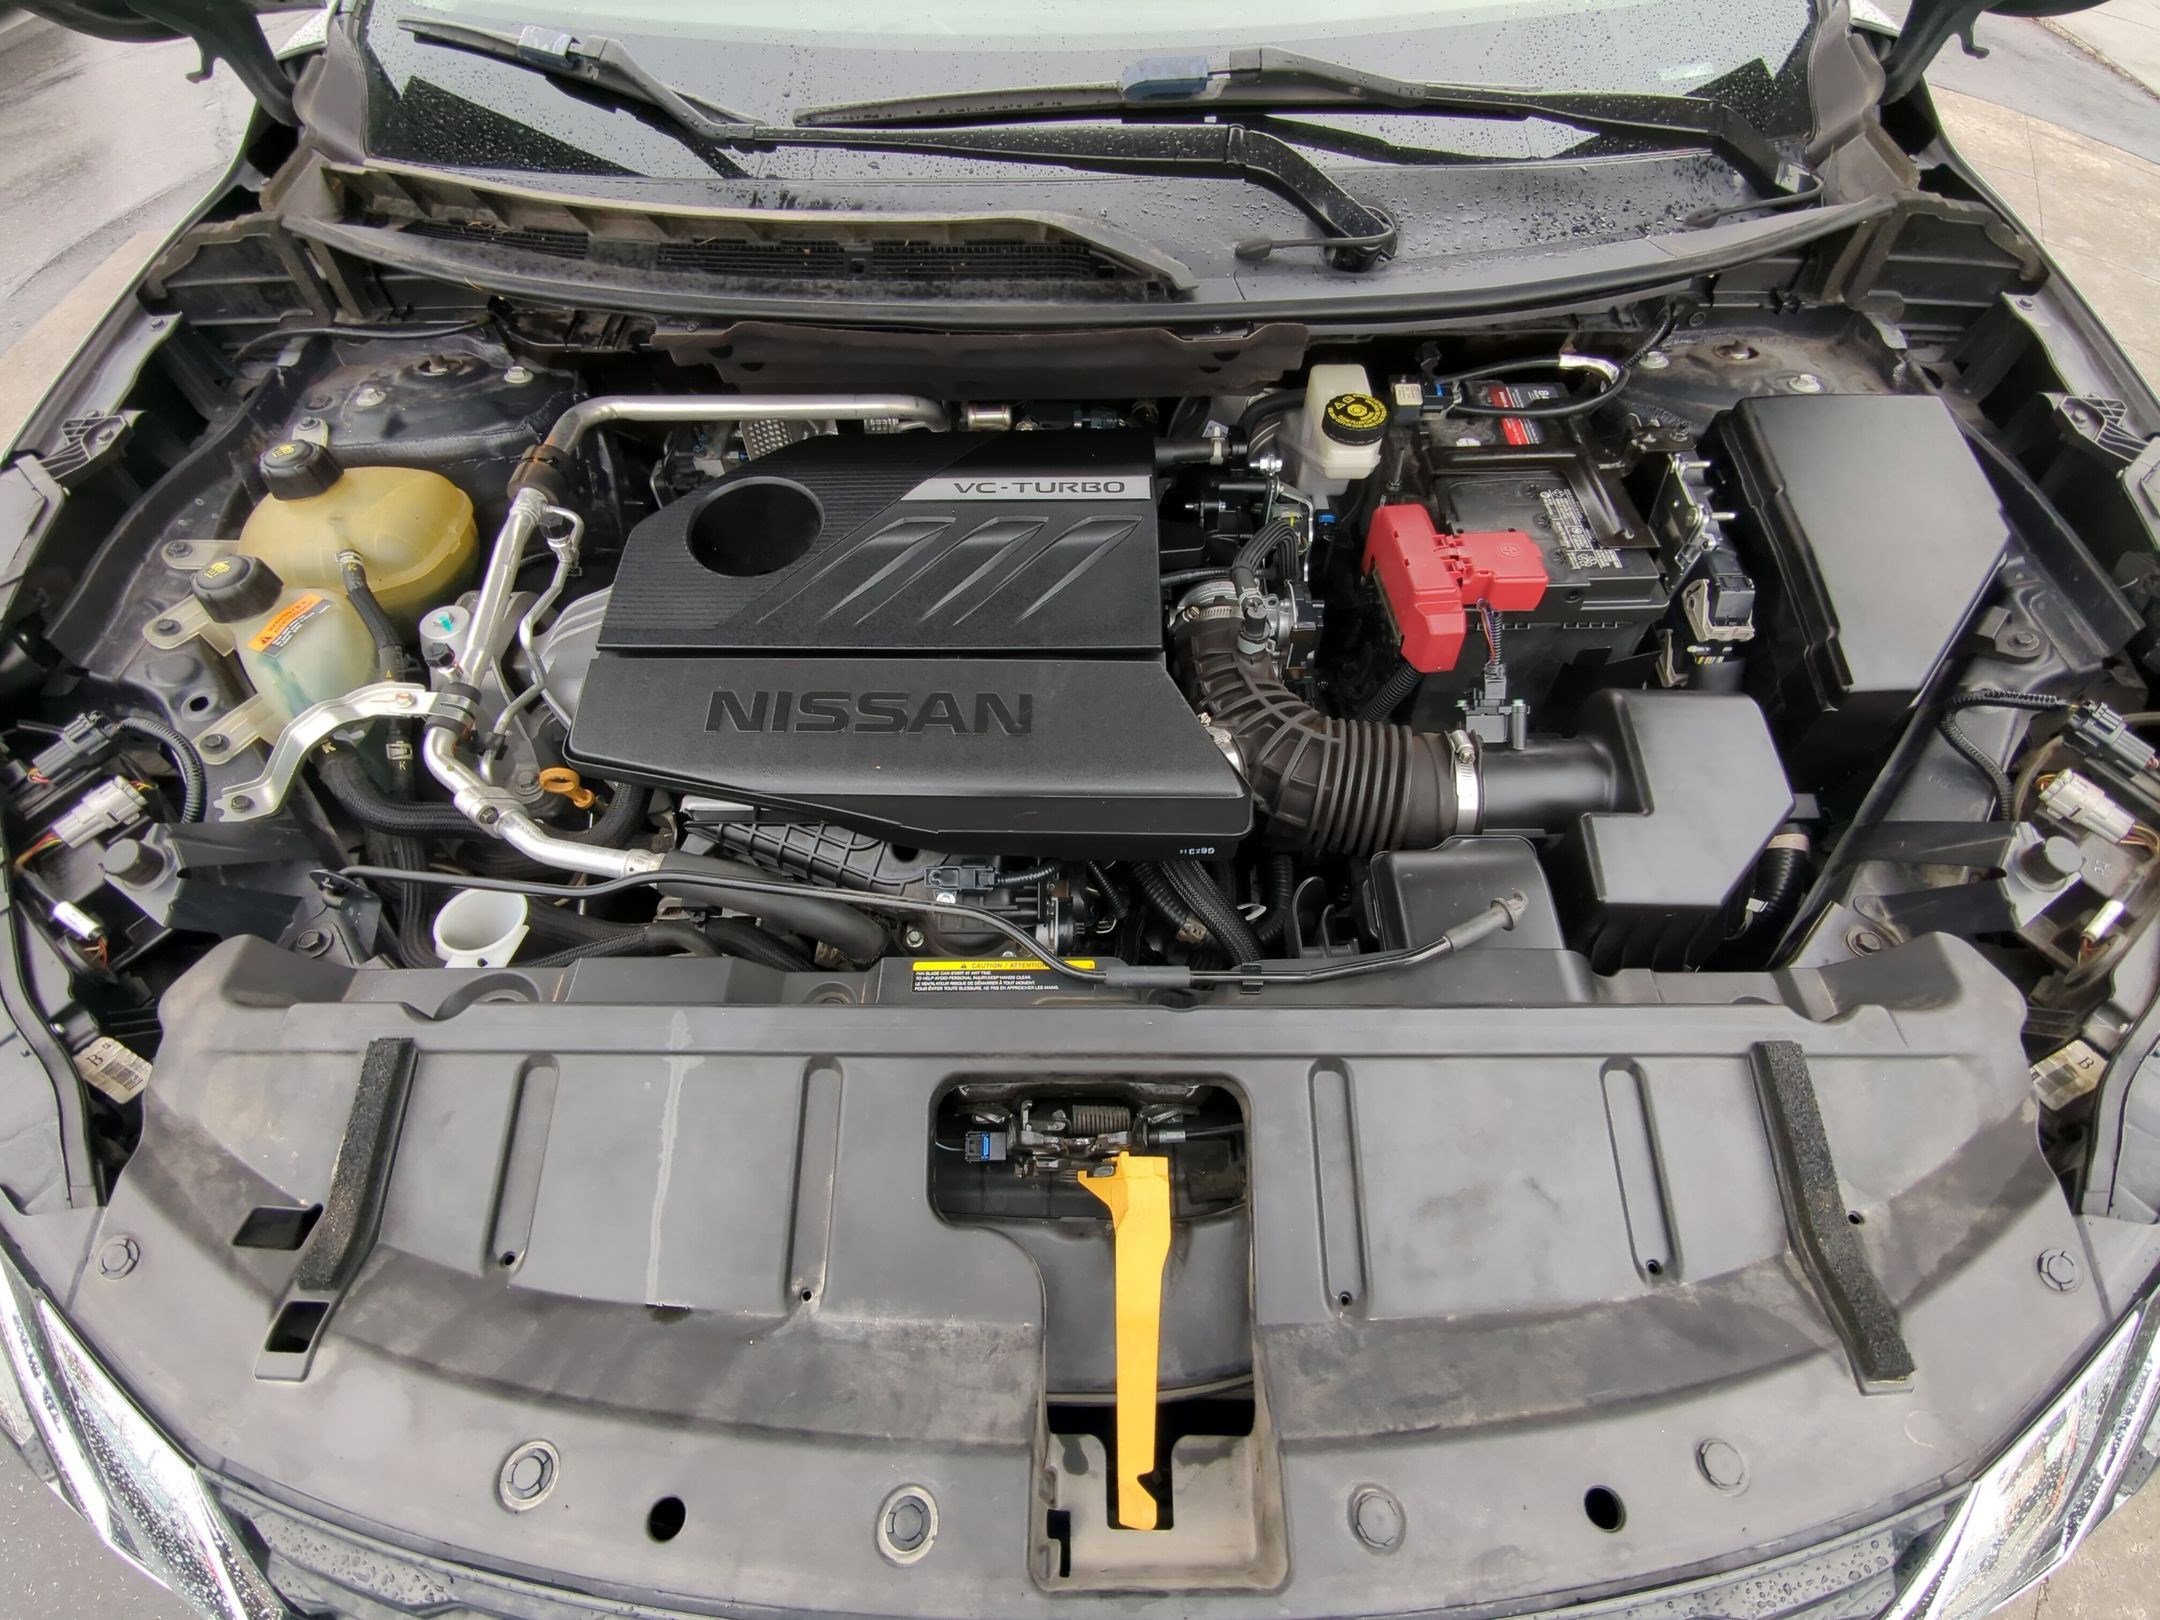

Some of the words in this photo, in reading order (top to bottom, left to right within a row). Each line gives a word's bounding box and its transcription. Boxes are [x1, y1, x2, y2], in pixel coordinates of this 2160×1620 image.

[953, 481, 1126, 494] VC-TURBO
[703, 689, 1034, 736] NISSAN
[399, 760, 407, 771] K
[86, 1054, 104, 1067] B
[2077, 1056, 2095, 1069] B
